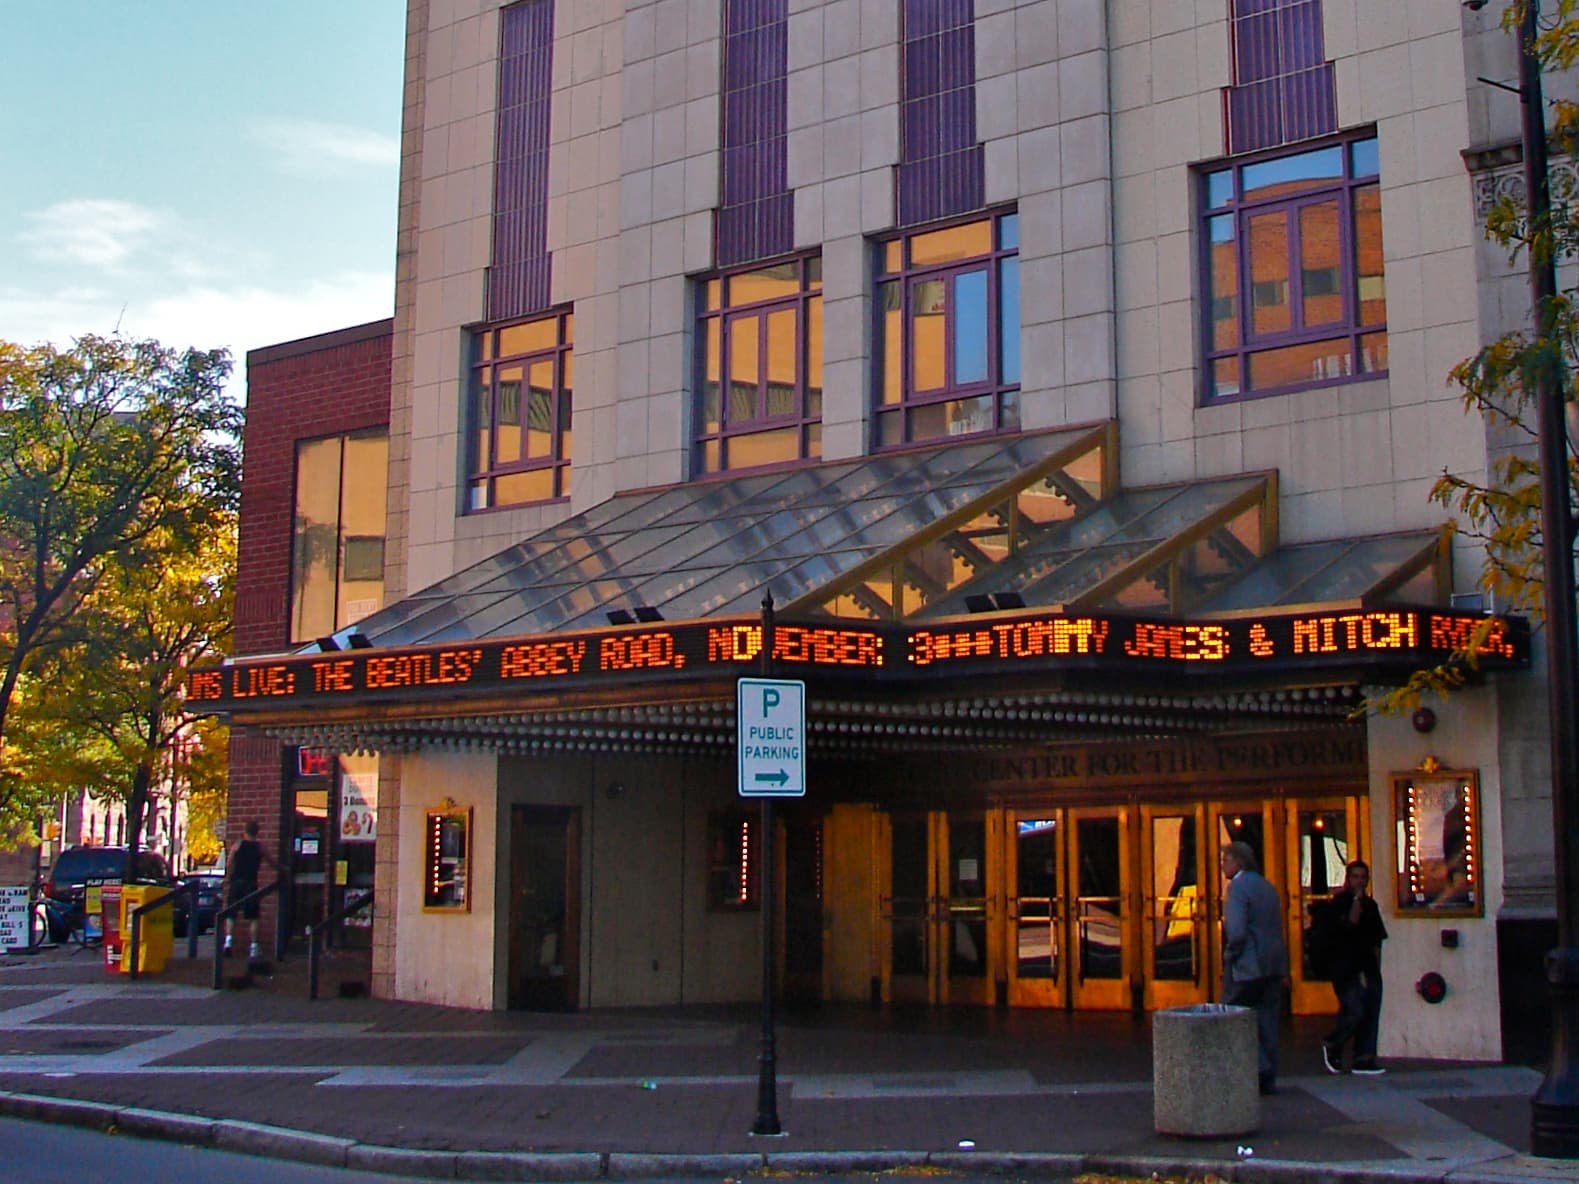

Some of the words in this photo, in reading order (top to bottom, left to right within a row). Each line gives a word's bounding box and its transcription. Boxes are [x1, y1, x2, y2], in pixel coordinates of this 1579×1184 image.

[232, 666, 295, 698] LIVE:
[312, 660, 354, 692] THE
[366, 650, 483, 688] BEATLES'
[501, 640, 586, 678] ABBEY
[600, 632, 686, 670] ROAD,
[1124, 623, 1230, 660] JAMES
[1250, 624, 1274, 657] &
[1293, 613, 1419, 654] MITCH
[763, 688, 780, 718] P
[749, 726, 794, 740] PUBLIC
[745, 746, 799, 760] PARKING
[973, 754, 1078, 782] CENTER
[1087, 750, 1140, 776] FOR
[1146, 746, 1207, 773] THE
